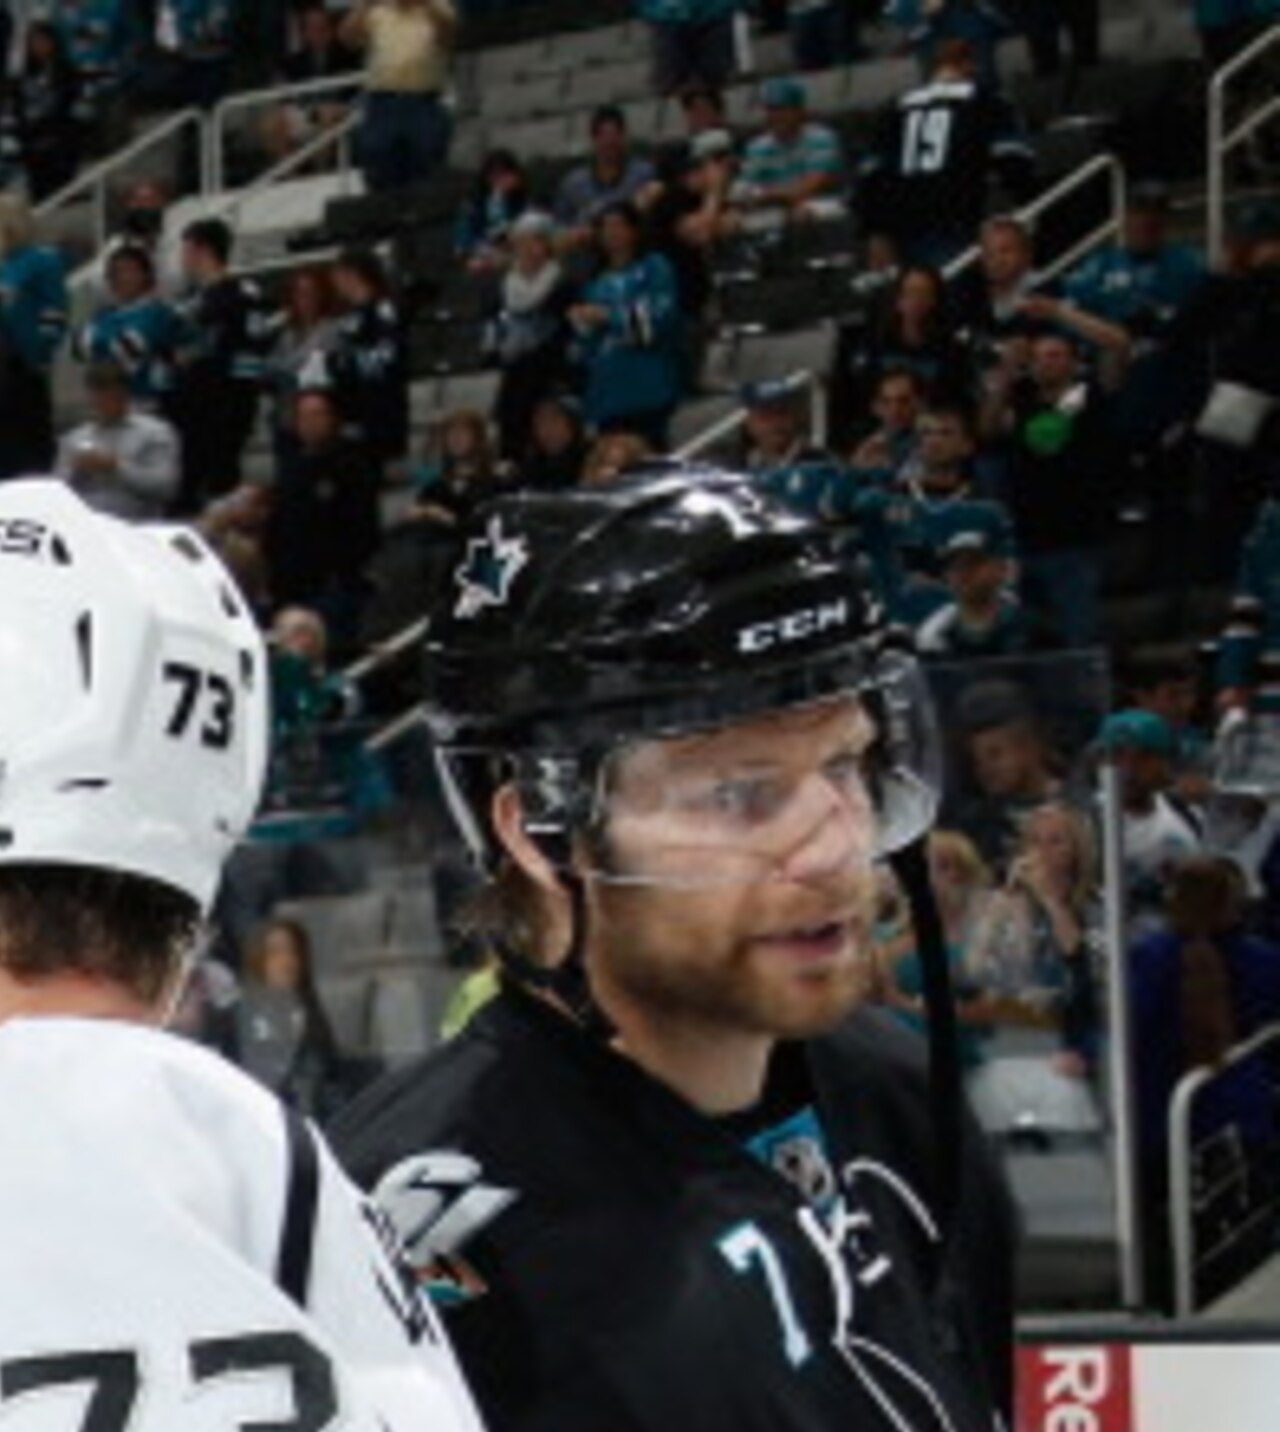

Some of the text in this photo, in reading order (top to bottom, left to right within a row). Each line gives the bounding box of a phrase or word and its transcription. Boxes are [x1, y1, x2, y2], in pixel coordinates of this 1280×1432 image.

[738, 600, 848, 652] CCM
[162, 661, 236, 750] 73
[716, 1221, 811, 1368] 7
